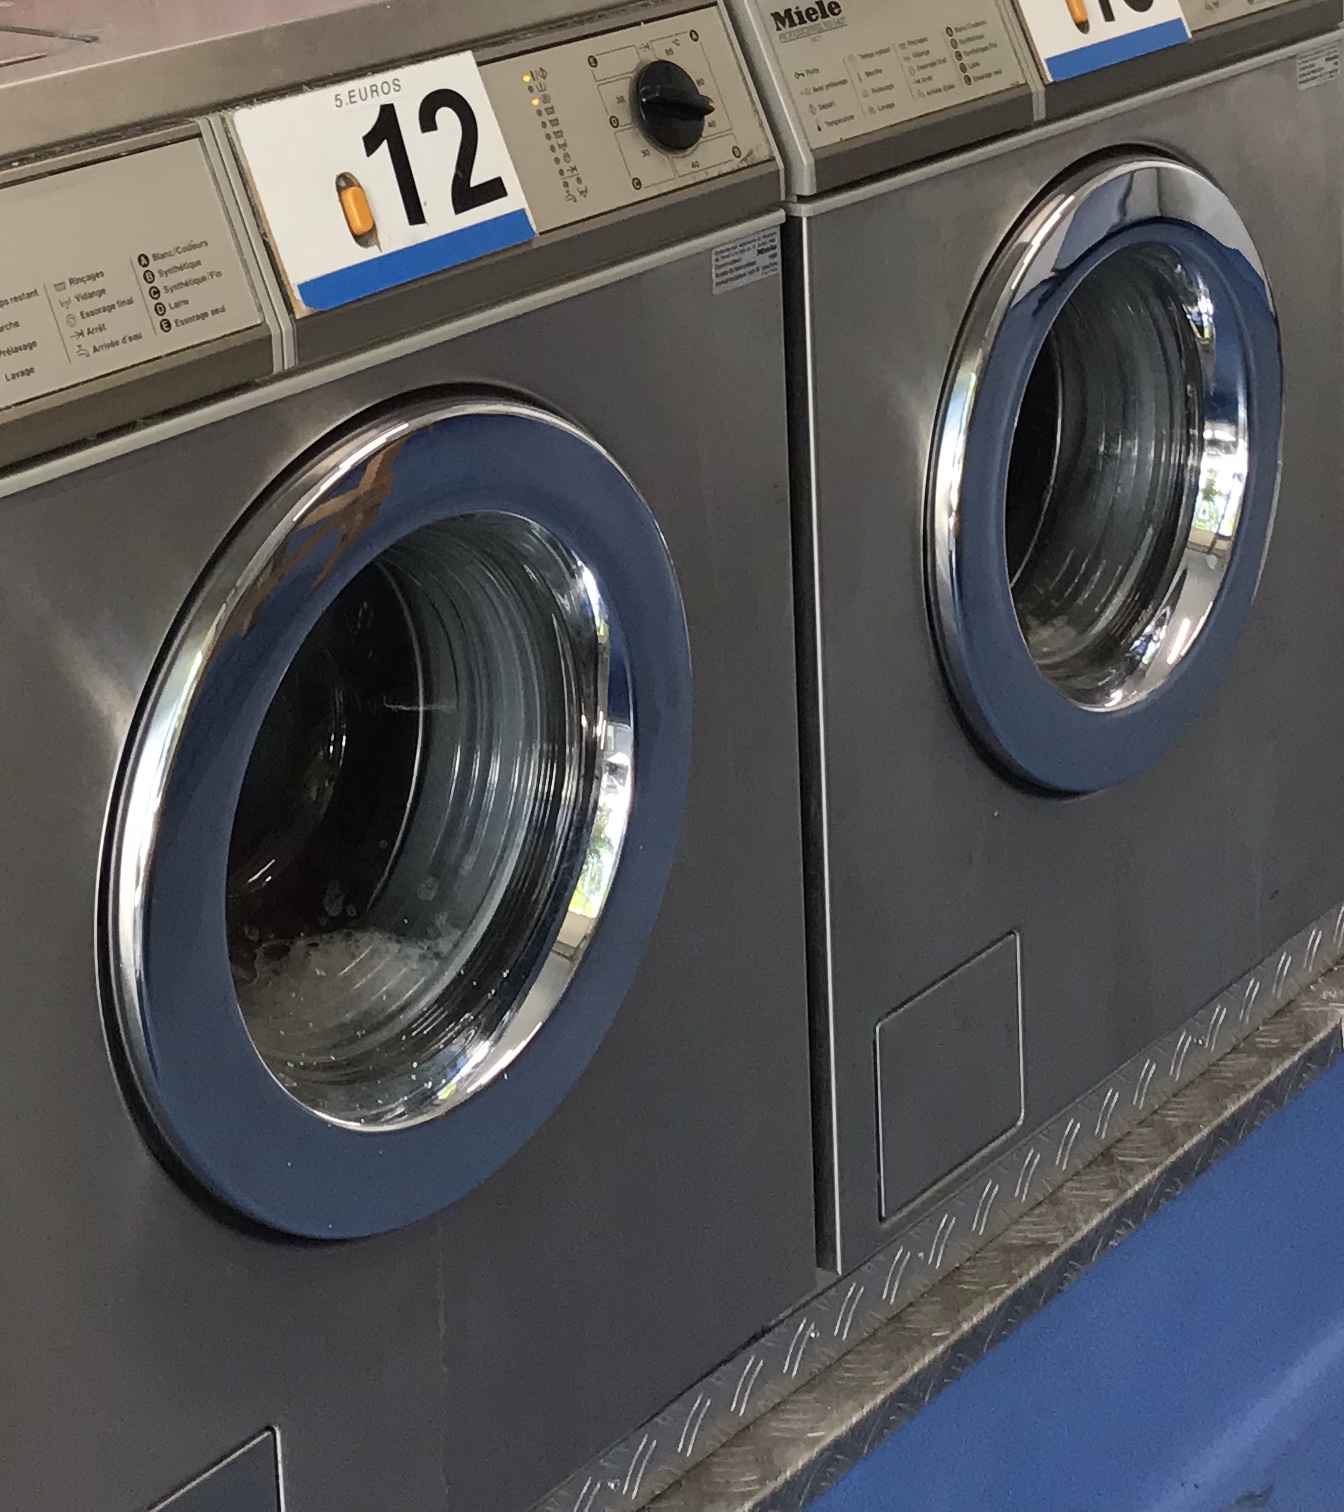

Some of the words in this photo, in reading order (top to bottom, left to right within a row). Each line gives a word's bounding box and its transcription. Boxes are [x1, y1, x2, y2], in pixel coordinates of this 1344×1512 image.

[770, 0, 842, 31] Miele
[335, 79, 400, 107] 5.EUROS
[362, 89, 508, 226] 12
